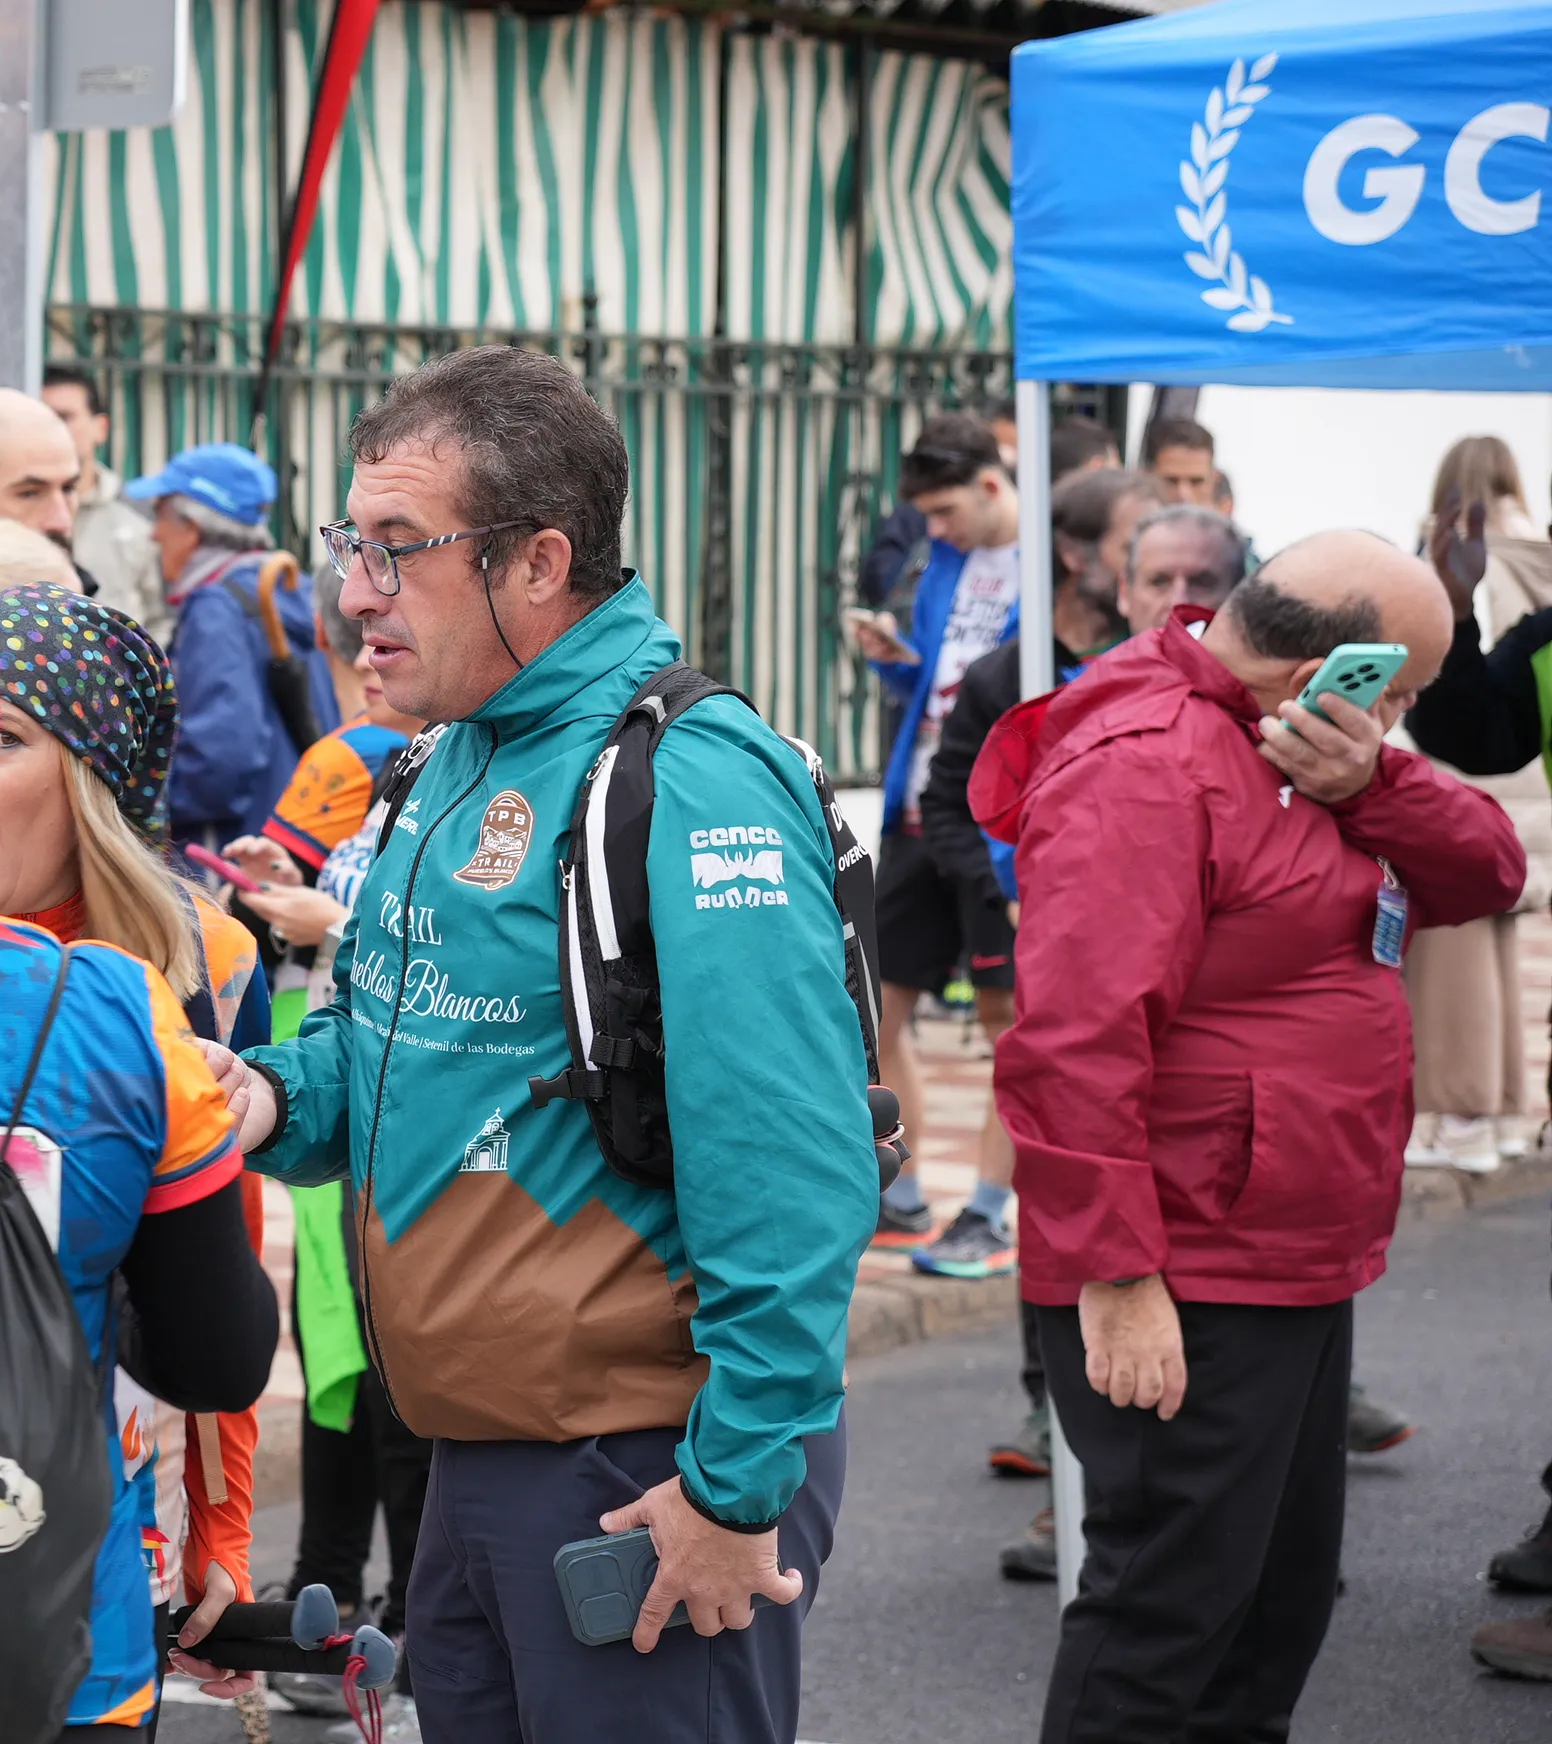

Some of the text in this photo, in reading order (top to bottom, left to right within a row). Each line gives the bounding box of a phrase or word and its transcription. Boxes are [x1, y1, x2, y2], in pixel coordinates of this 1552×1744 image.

[1302, 101, 1551, 246] GC
[399, 958, 527, 1024] Blancos
[451, 1043, 465, 1054] de
[467, 1042, 484, 1054] las
[486, 1043, 535, 1057] Bodegas
